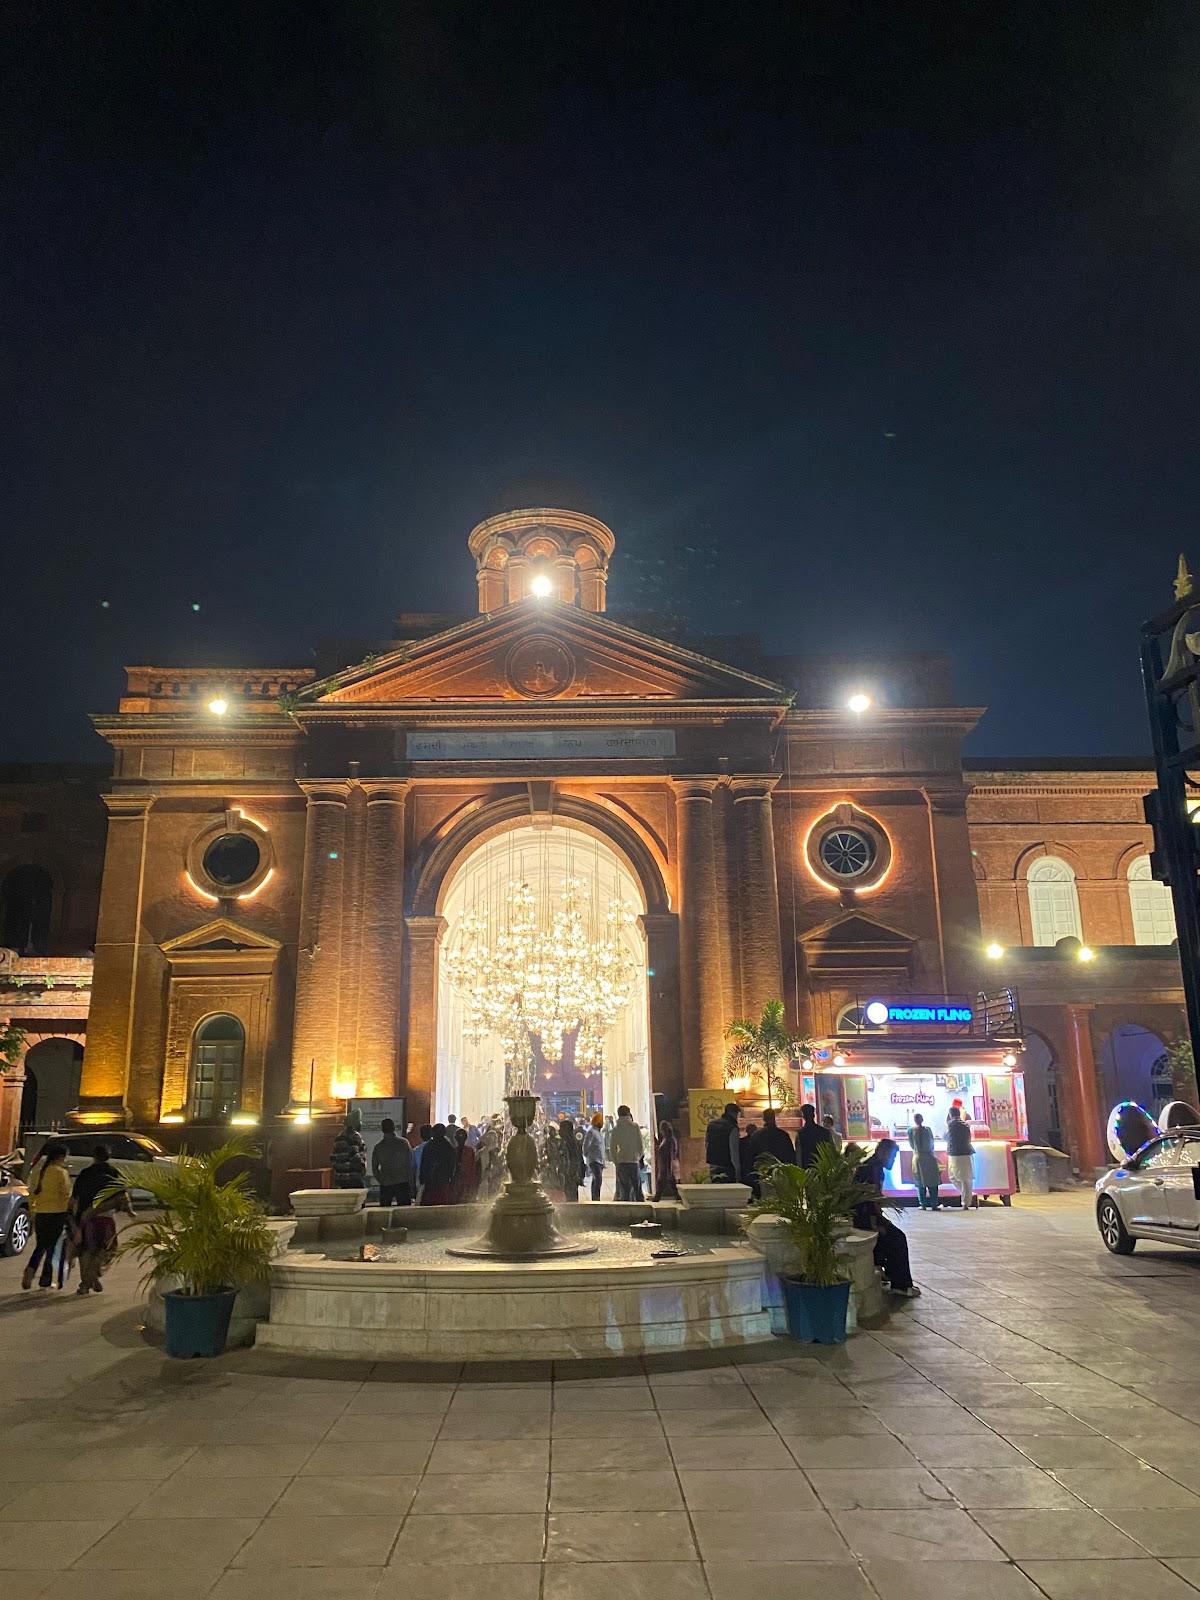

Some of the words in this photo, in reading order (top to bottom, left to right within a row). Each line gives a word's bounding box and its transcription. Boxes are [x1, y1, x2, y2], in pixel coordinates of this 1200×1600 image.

[888, 1008, 935, 1021] FROZEN
[937, 1008, 972, 1021] FLING
[890, 1093, 914, 1104] Frozen
